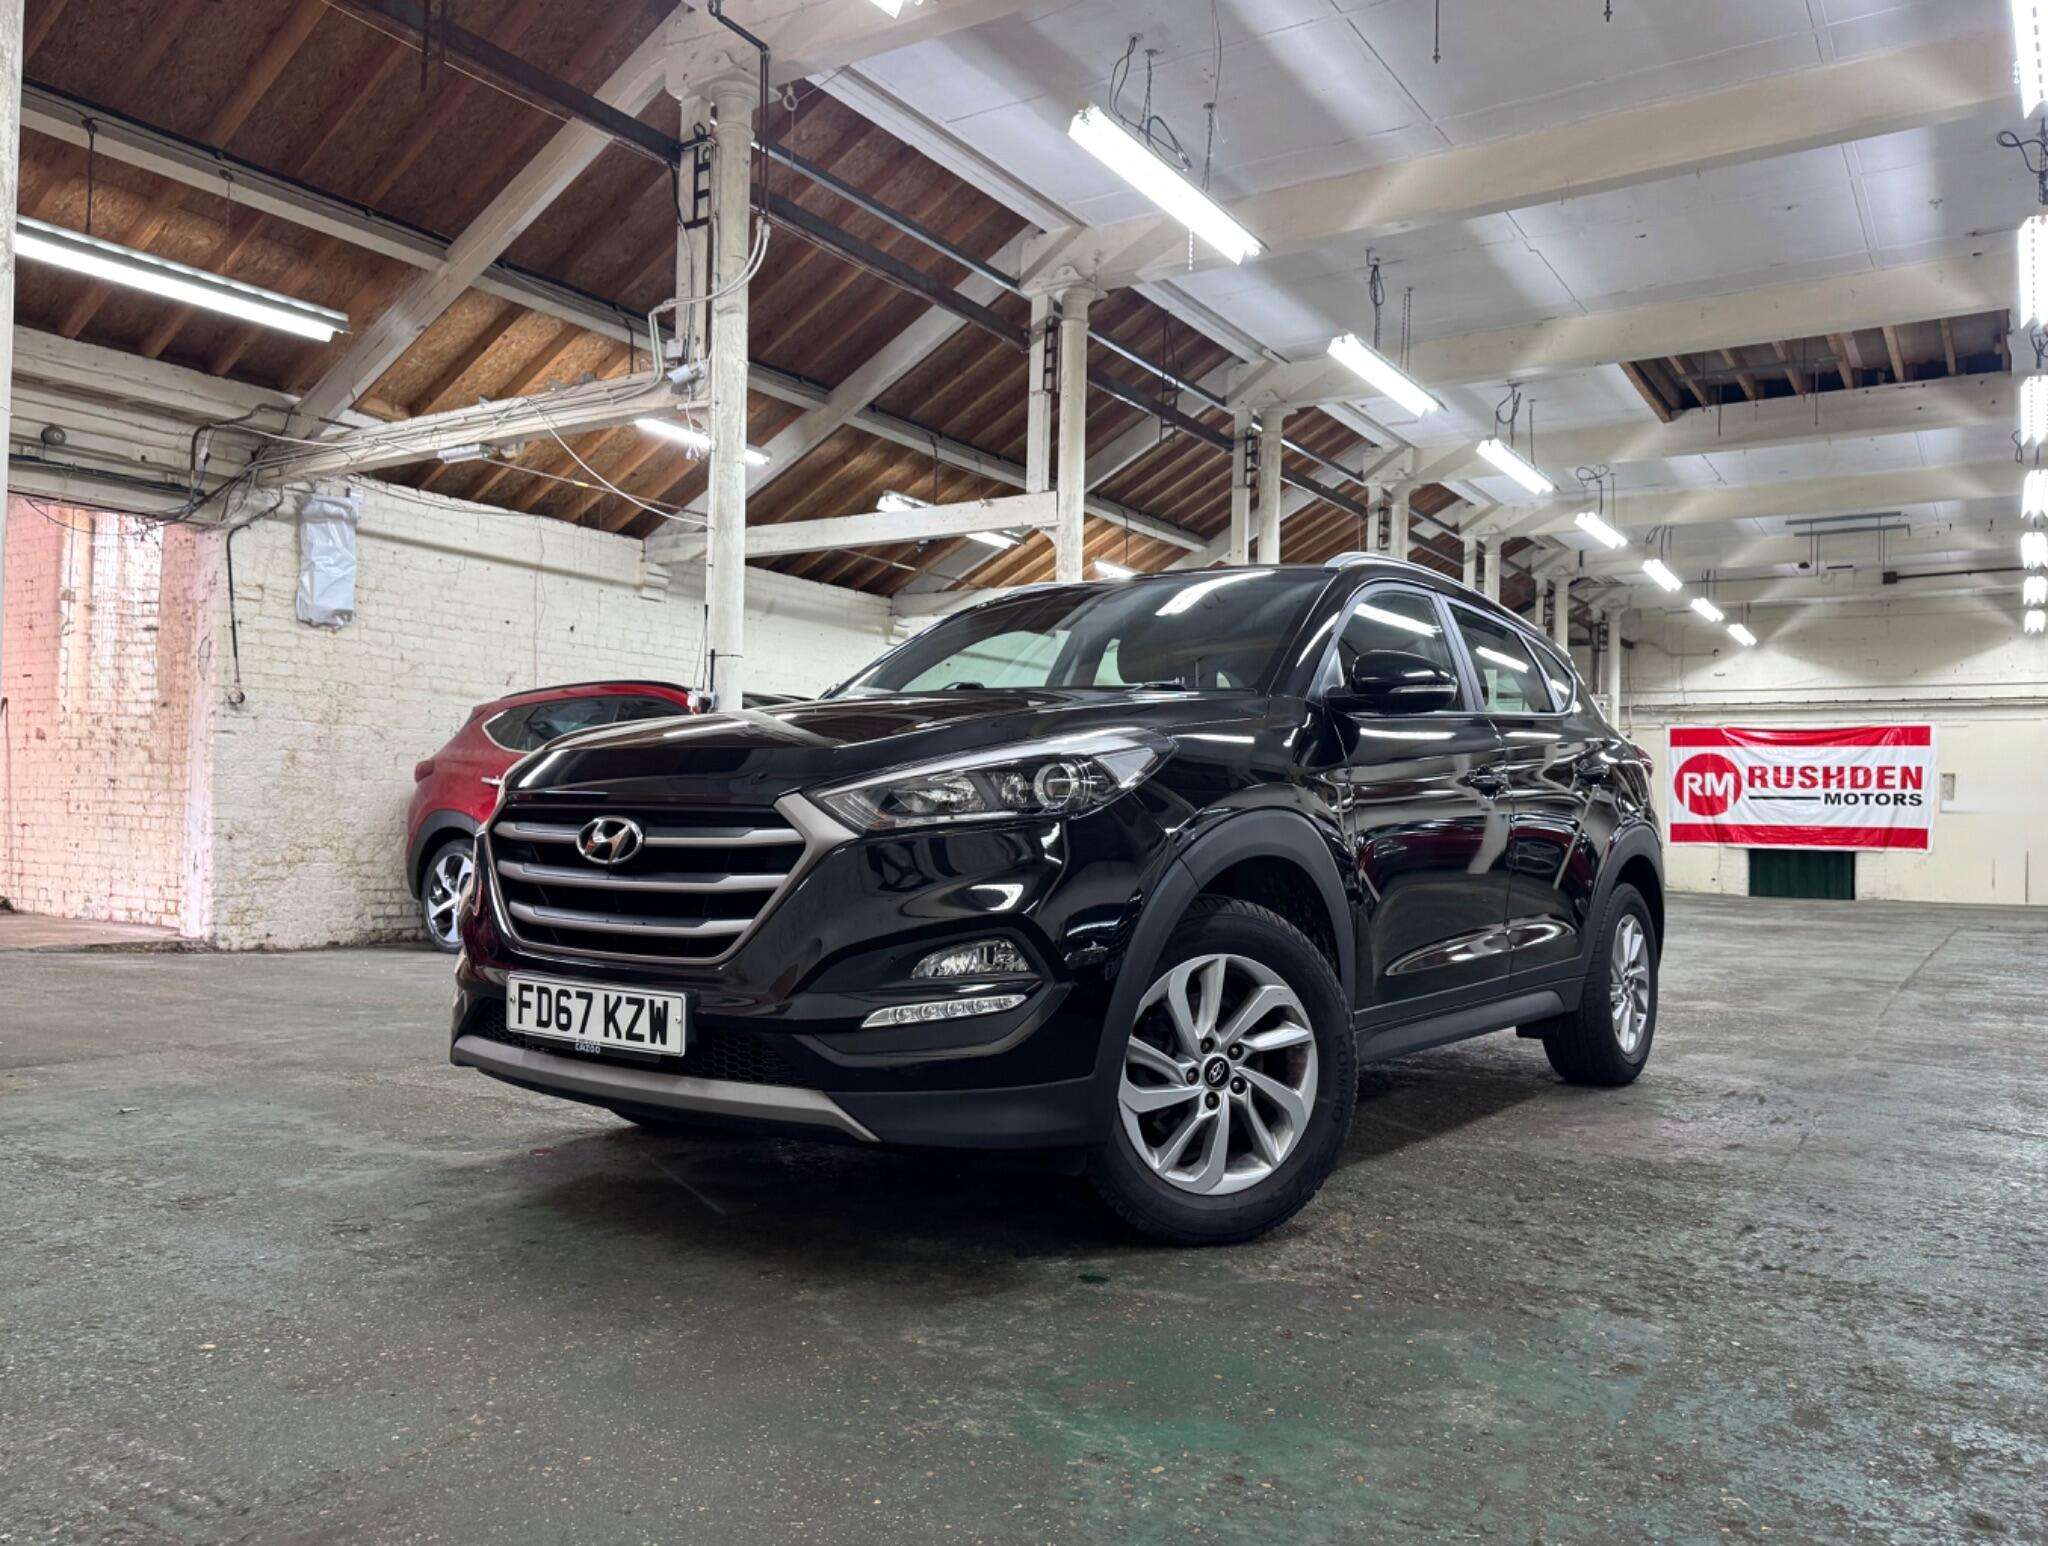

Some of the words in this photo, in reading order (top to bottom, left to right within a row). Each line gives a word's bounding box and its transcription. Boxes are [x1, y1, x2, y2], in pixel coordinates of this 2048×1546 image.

[1683, 772, 1735, 807] RM
[1749, 766, 1923, 789] RUSHDEN
[1824, 793, 1922, 806] MOTORS
[517, 983, 593, 1034] FD67
[604, 993, 668, 1045] KZW
